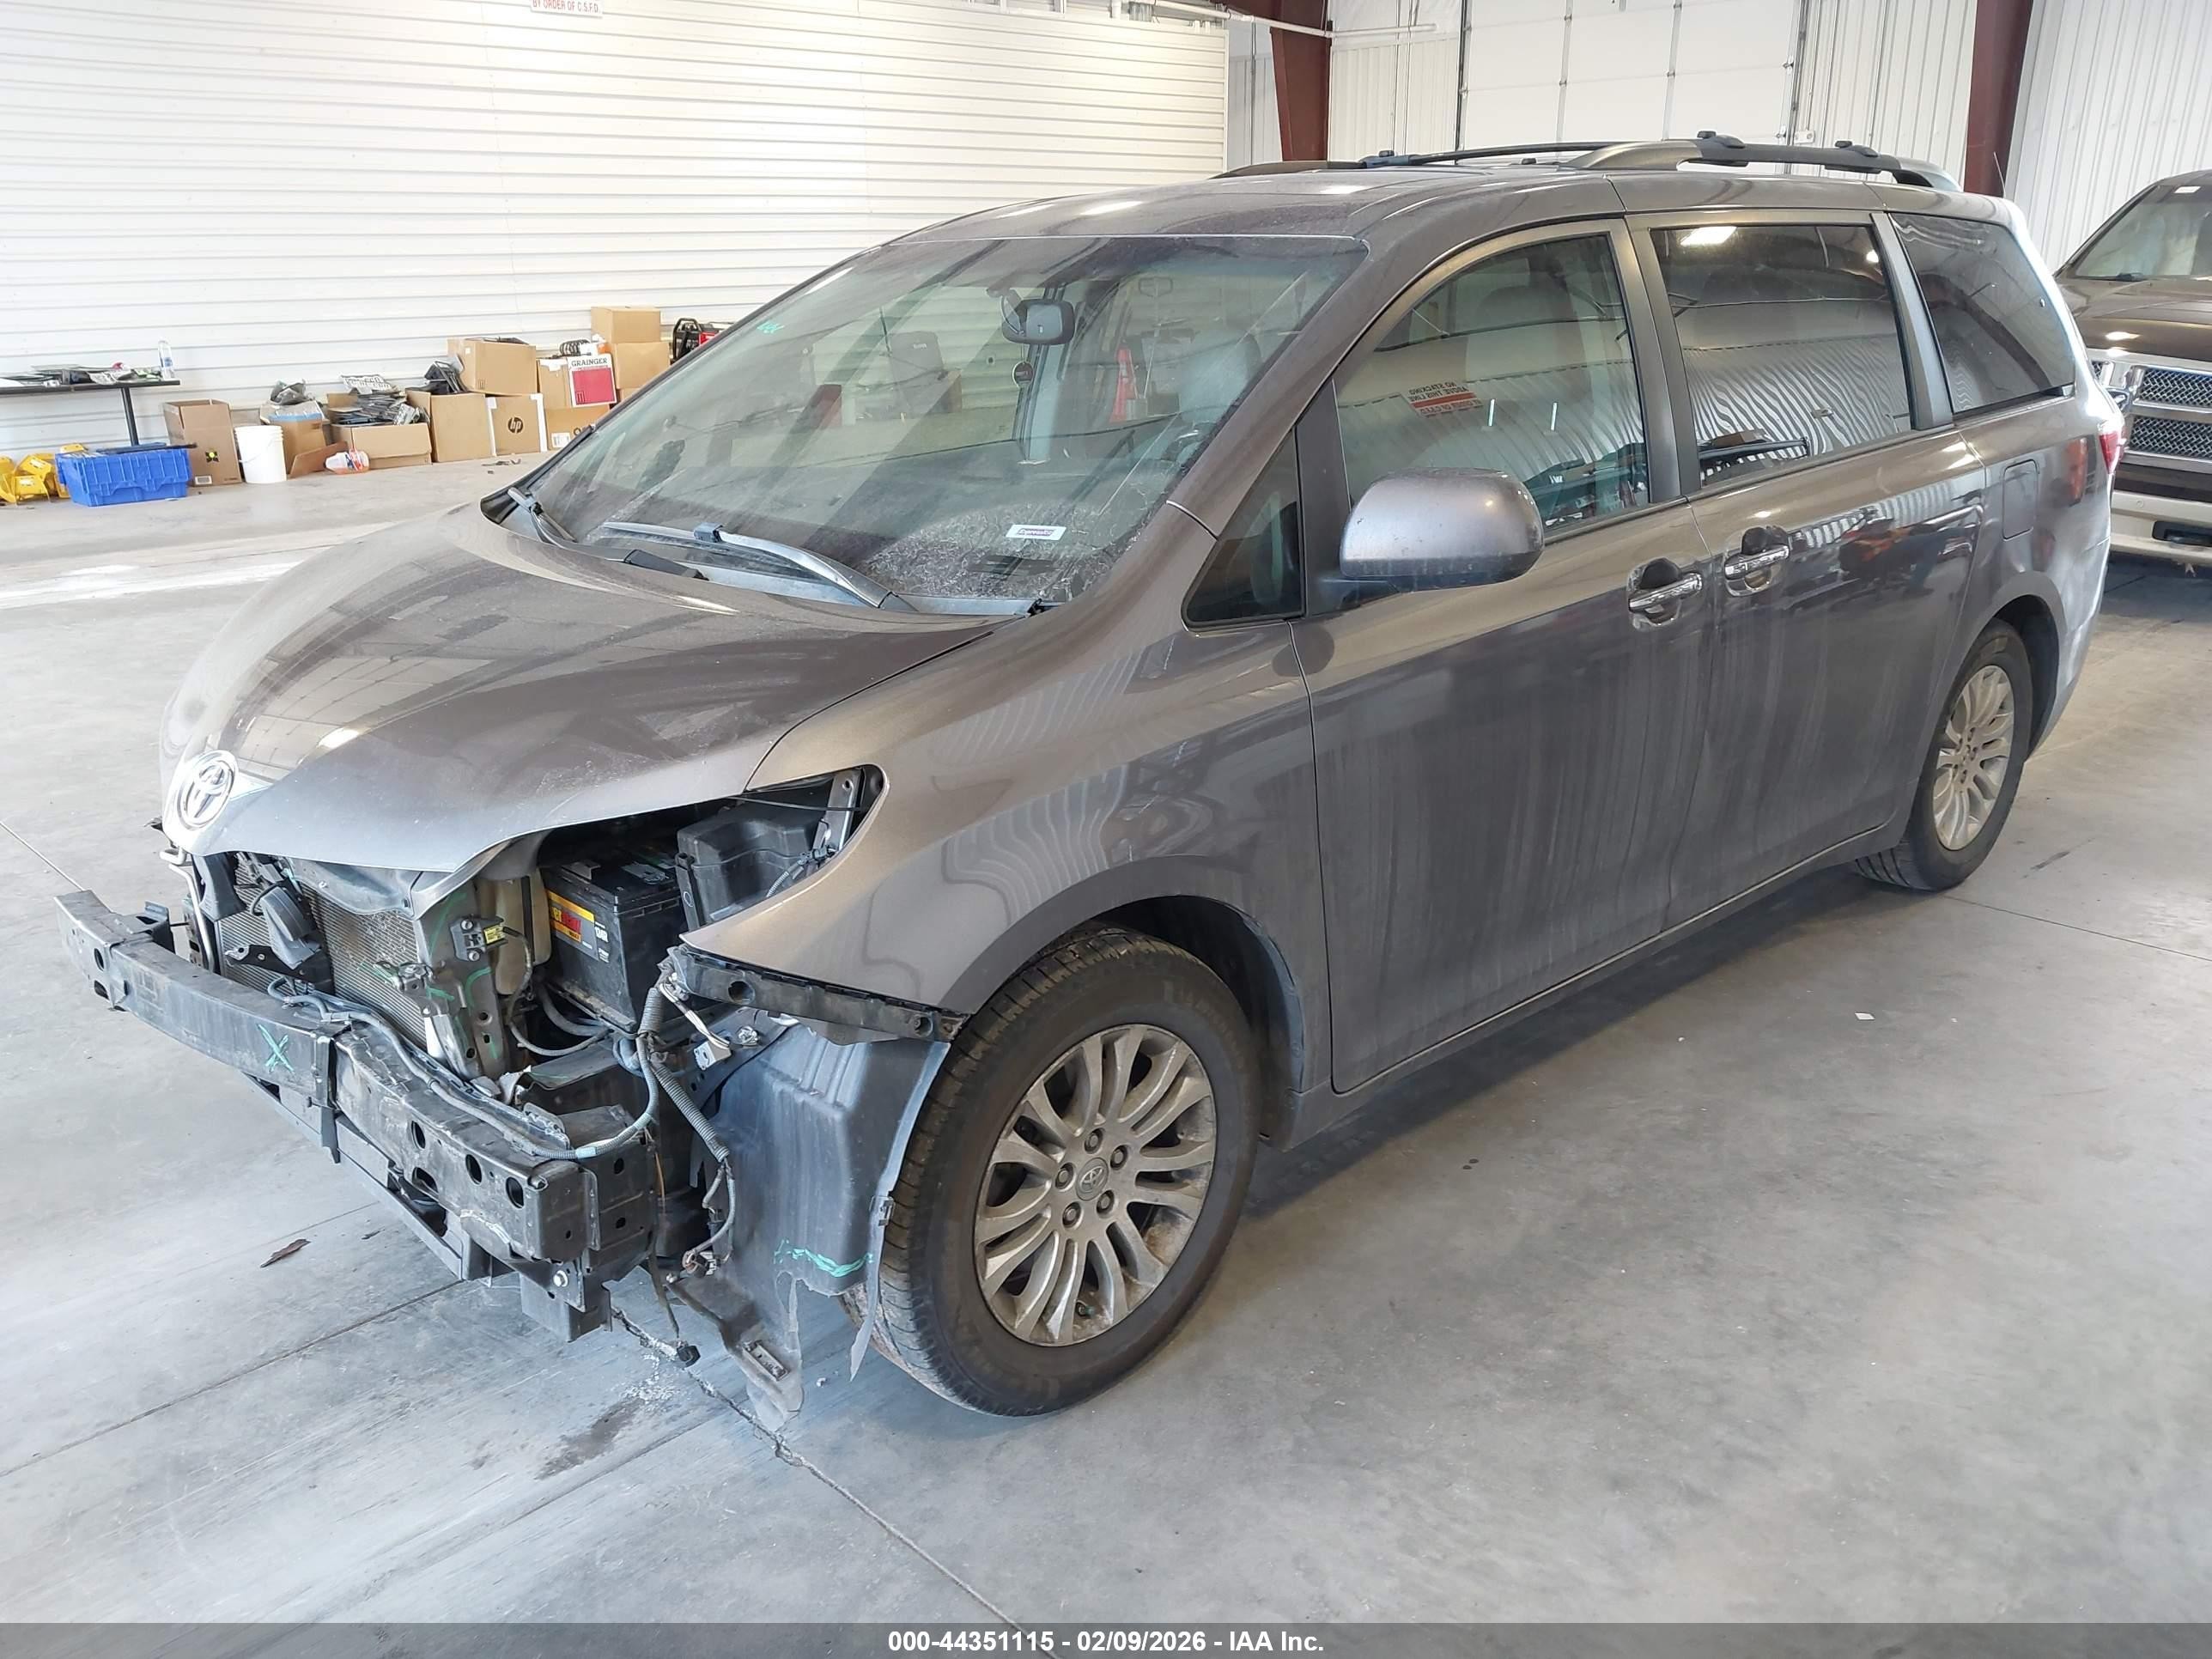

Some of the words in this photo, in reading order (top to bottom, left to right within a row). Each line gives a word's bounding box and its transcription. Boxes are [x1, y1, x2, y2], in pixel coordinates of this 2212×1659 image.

[544, 0, 566, 9] ORDER
[568, 1, 575, 11] OF
[571, 357, 608, 368] GRAINGER
[509, 417, 522, 434] hp
